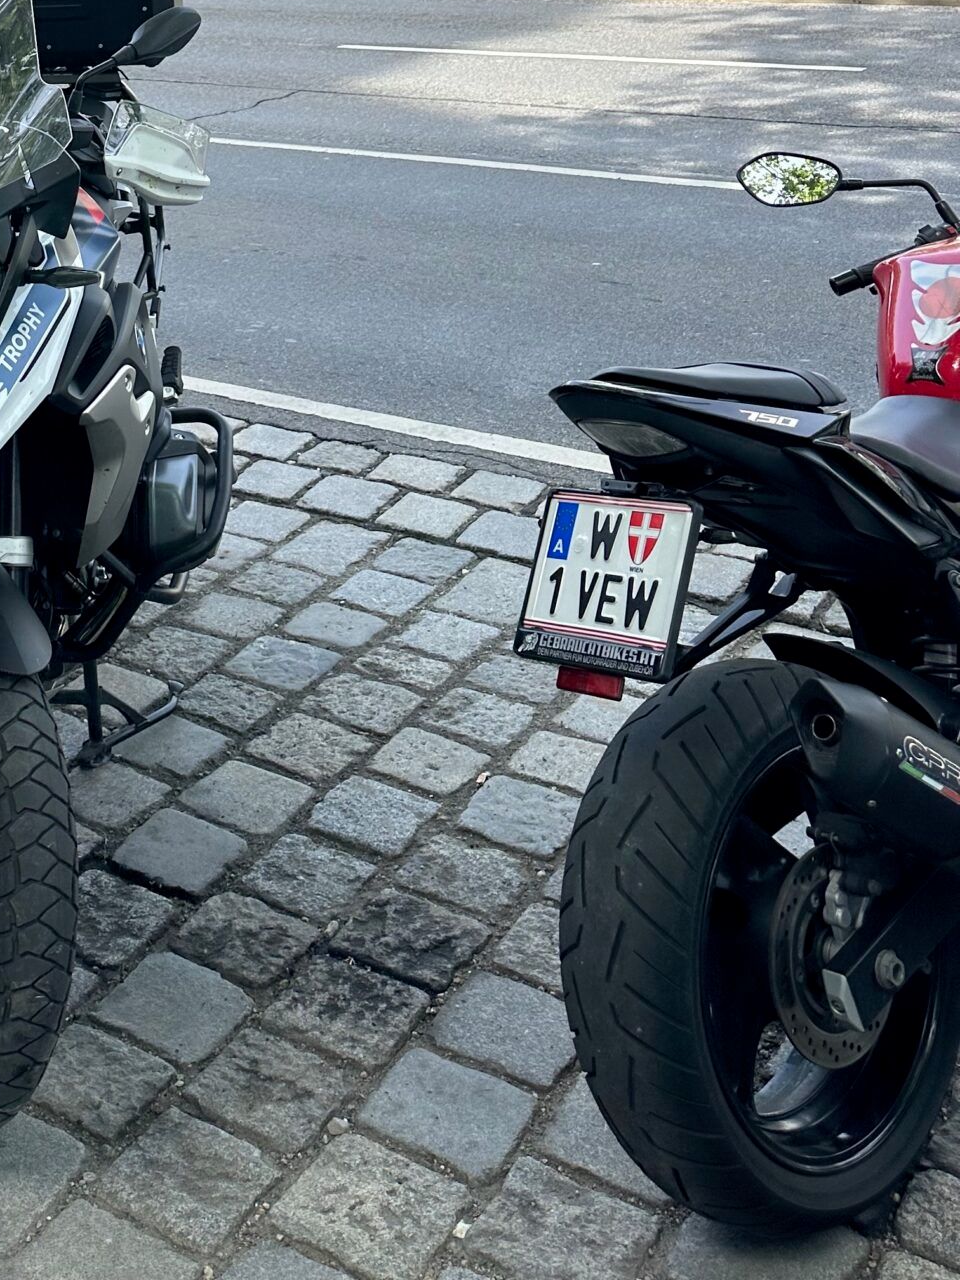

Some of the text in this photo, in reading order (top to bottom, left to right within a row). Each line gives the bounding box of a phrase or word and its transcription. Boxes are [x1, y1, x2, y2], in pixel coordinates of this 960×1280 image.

[738, 408, 800, 428] 750
[590, 510, 624, 562] W
[552, 538, 565, 555] A
[629, 566, 644, 574] WIEN
[578, 569, 660, 632] VEW
[537, 648, 550, 658] DEIN
[550, 650, 573, 662] PARTNER
[539, 633, 658, 667] GEBRAUCHTBIKES.AT
